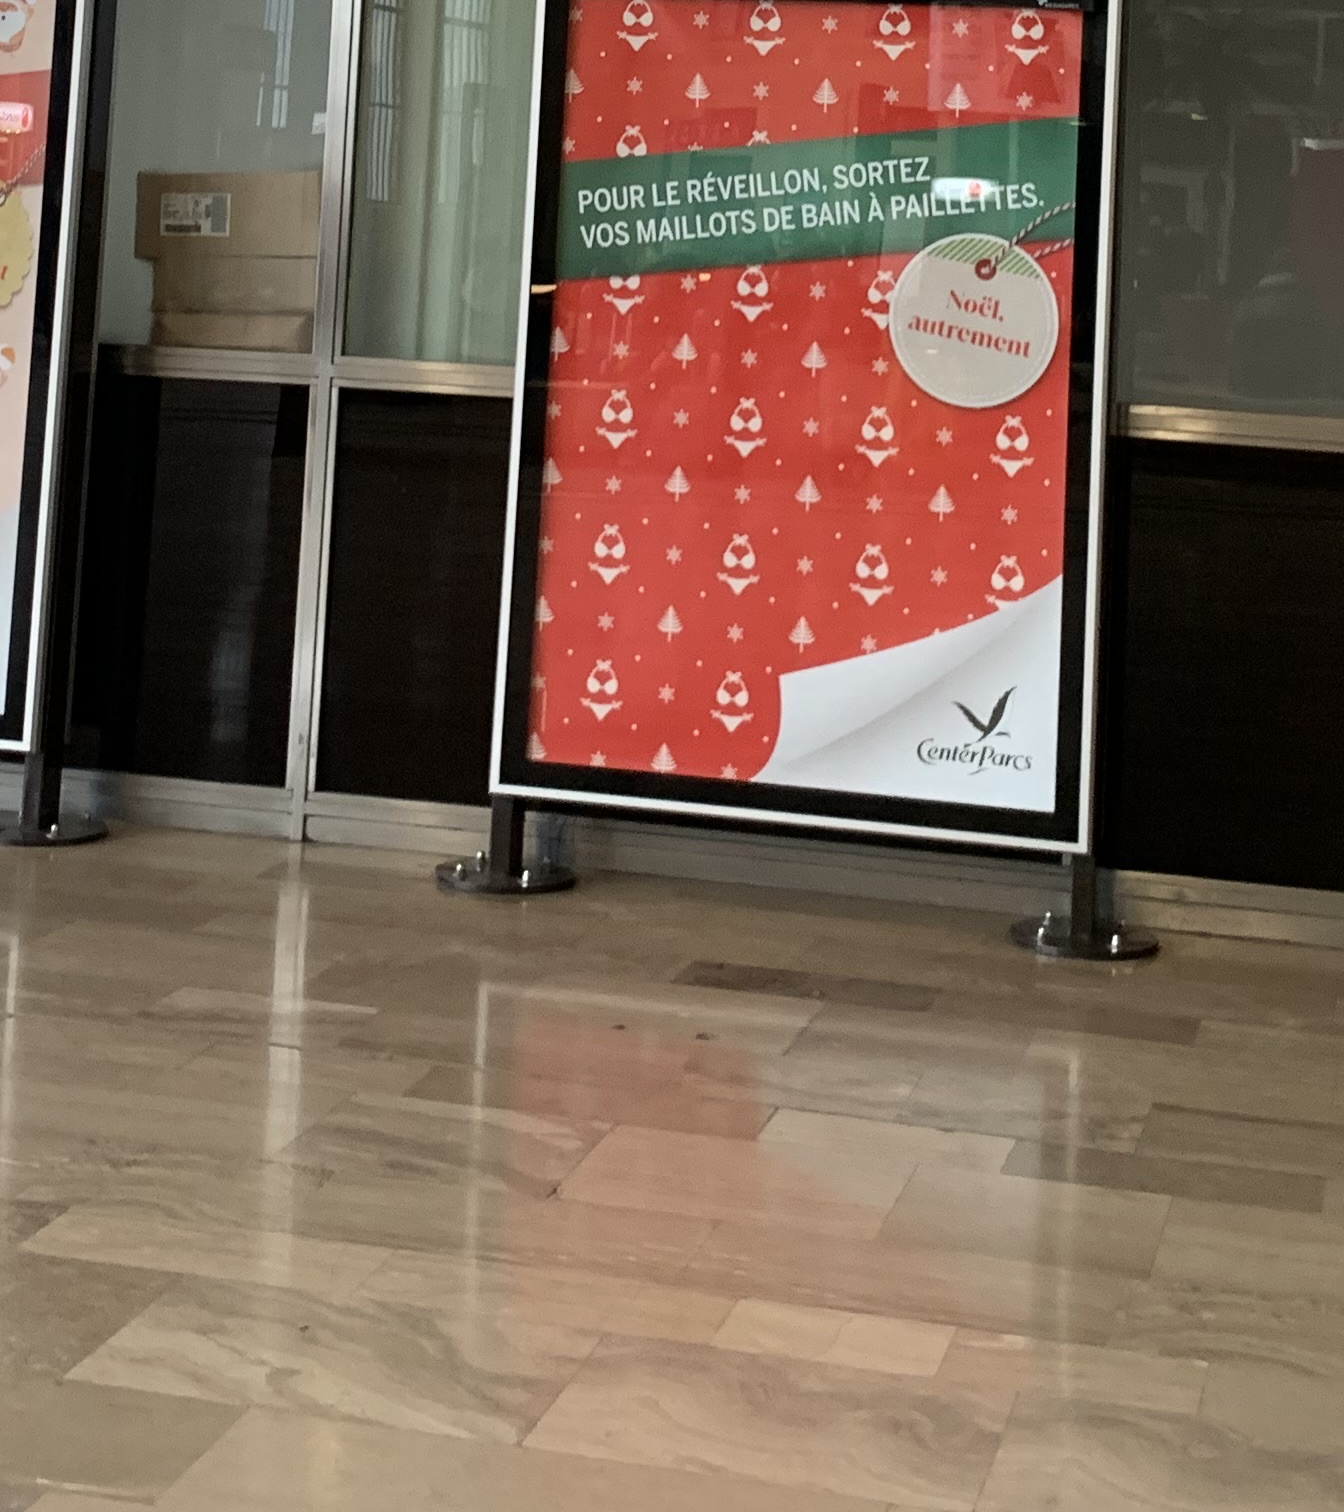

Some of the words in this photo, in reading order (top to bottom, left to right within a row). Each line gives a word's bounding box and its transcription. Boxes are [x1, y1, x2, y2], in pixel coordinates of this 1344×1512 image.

[578, 185, 645, 214] POUR
[652, 181, 681, 207] LE
[686, 168, 828, 204] RÉVEILLON,
[833, 156, 931, 189] SORTEZ
[580, 221, 630, 249] VOS
[636, 209, 756, 244] MAILLOTS
[763, 205, 795, 232] DE
[801, 200, 860, 228] BAIN
[868, 192, 884, 222] À
[908, 315, 1031, 358] autrement
